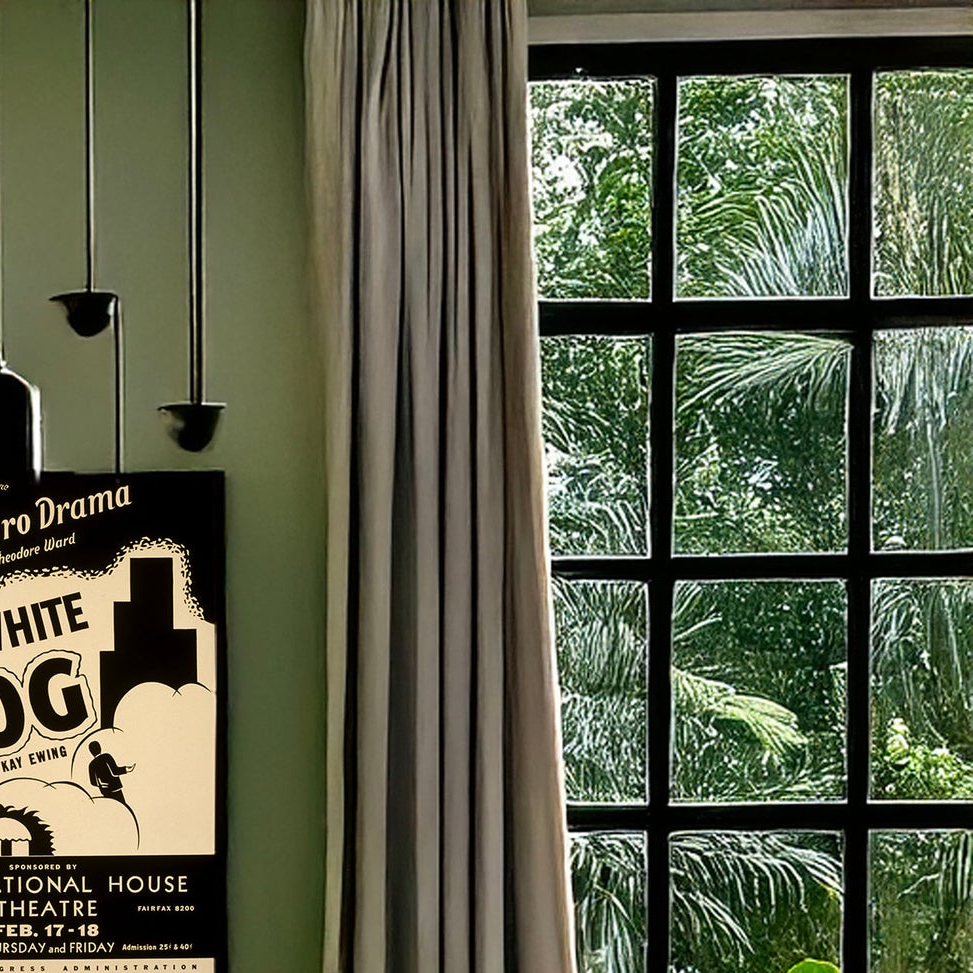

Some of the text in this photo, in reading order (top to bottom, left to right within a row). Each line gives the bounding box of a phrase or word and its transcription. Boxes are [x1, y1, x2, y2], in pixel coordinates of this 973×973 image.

[35, 484, 132, 530] Drama
[44, 532, 76, 551] Ward
[0, 756, 23, 773] KAY
[28, 745, 68, 765] EWING
[8, 863, 77, 871] SPONSORED BY
[109, 875, 188, 893] HOUSE
[48, 943, 66, 954] and
[69, 942, 115, 953] FRIDAY
[122, 943, 157, 951] Admission
[63, 964, 197, 972] ADMINISTRATION
